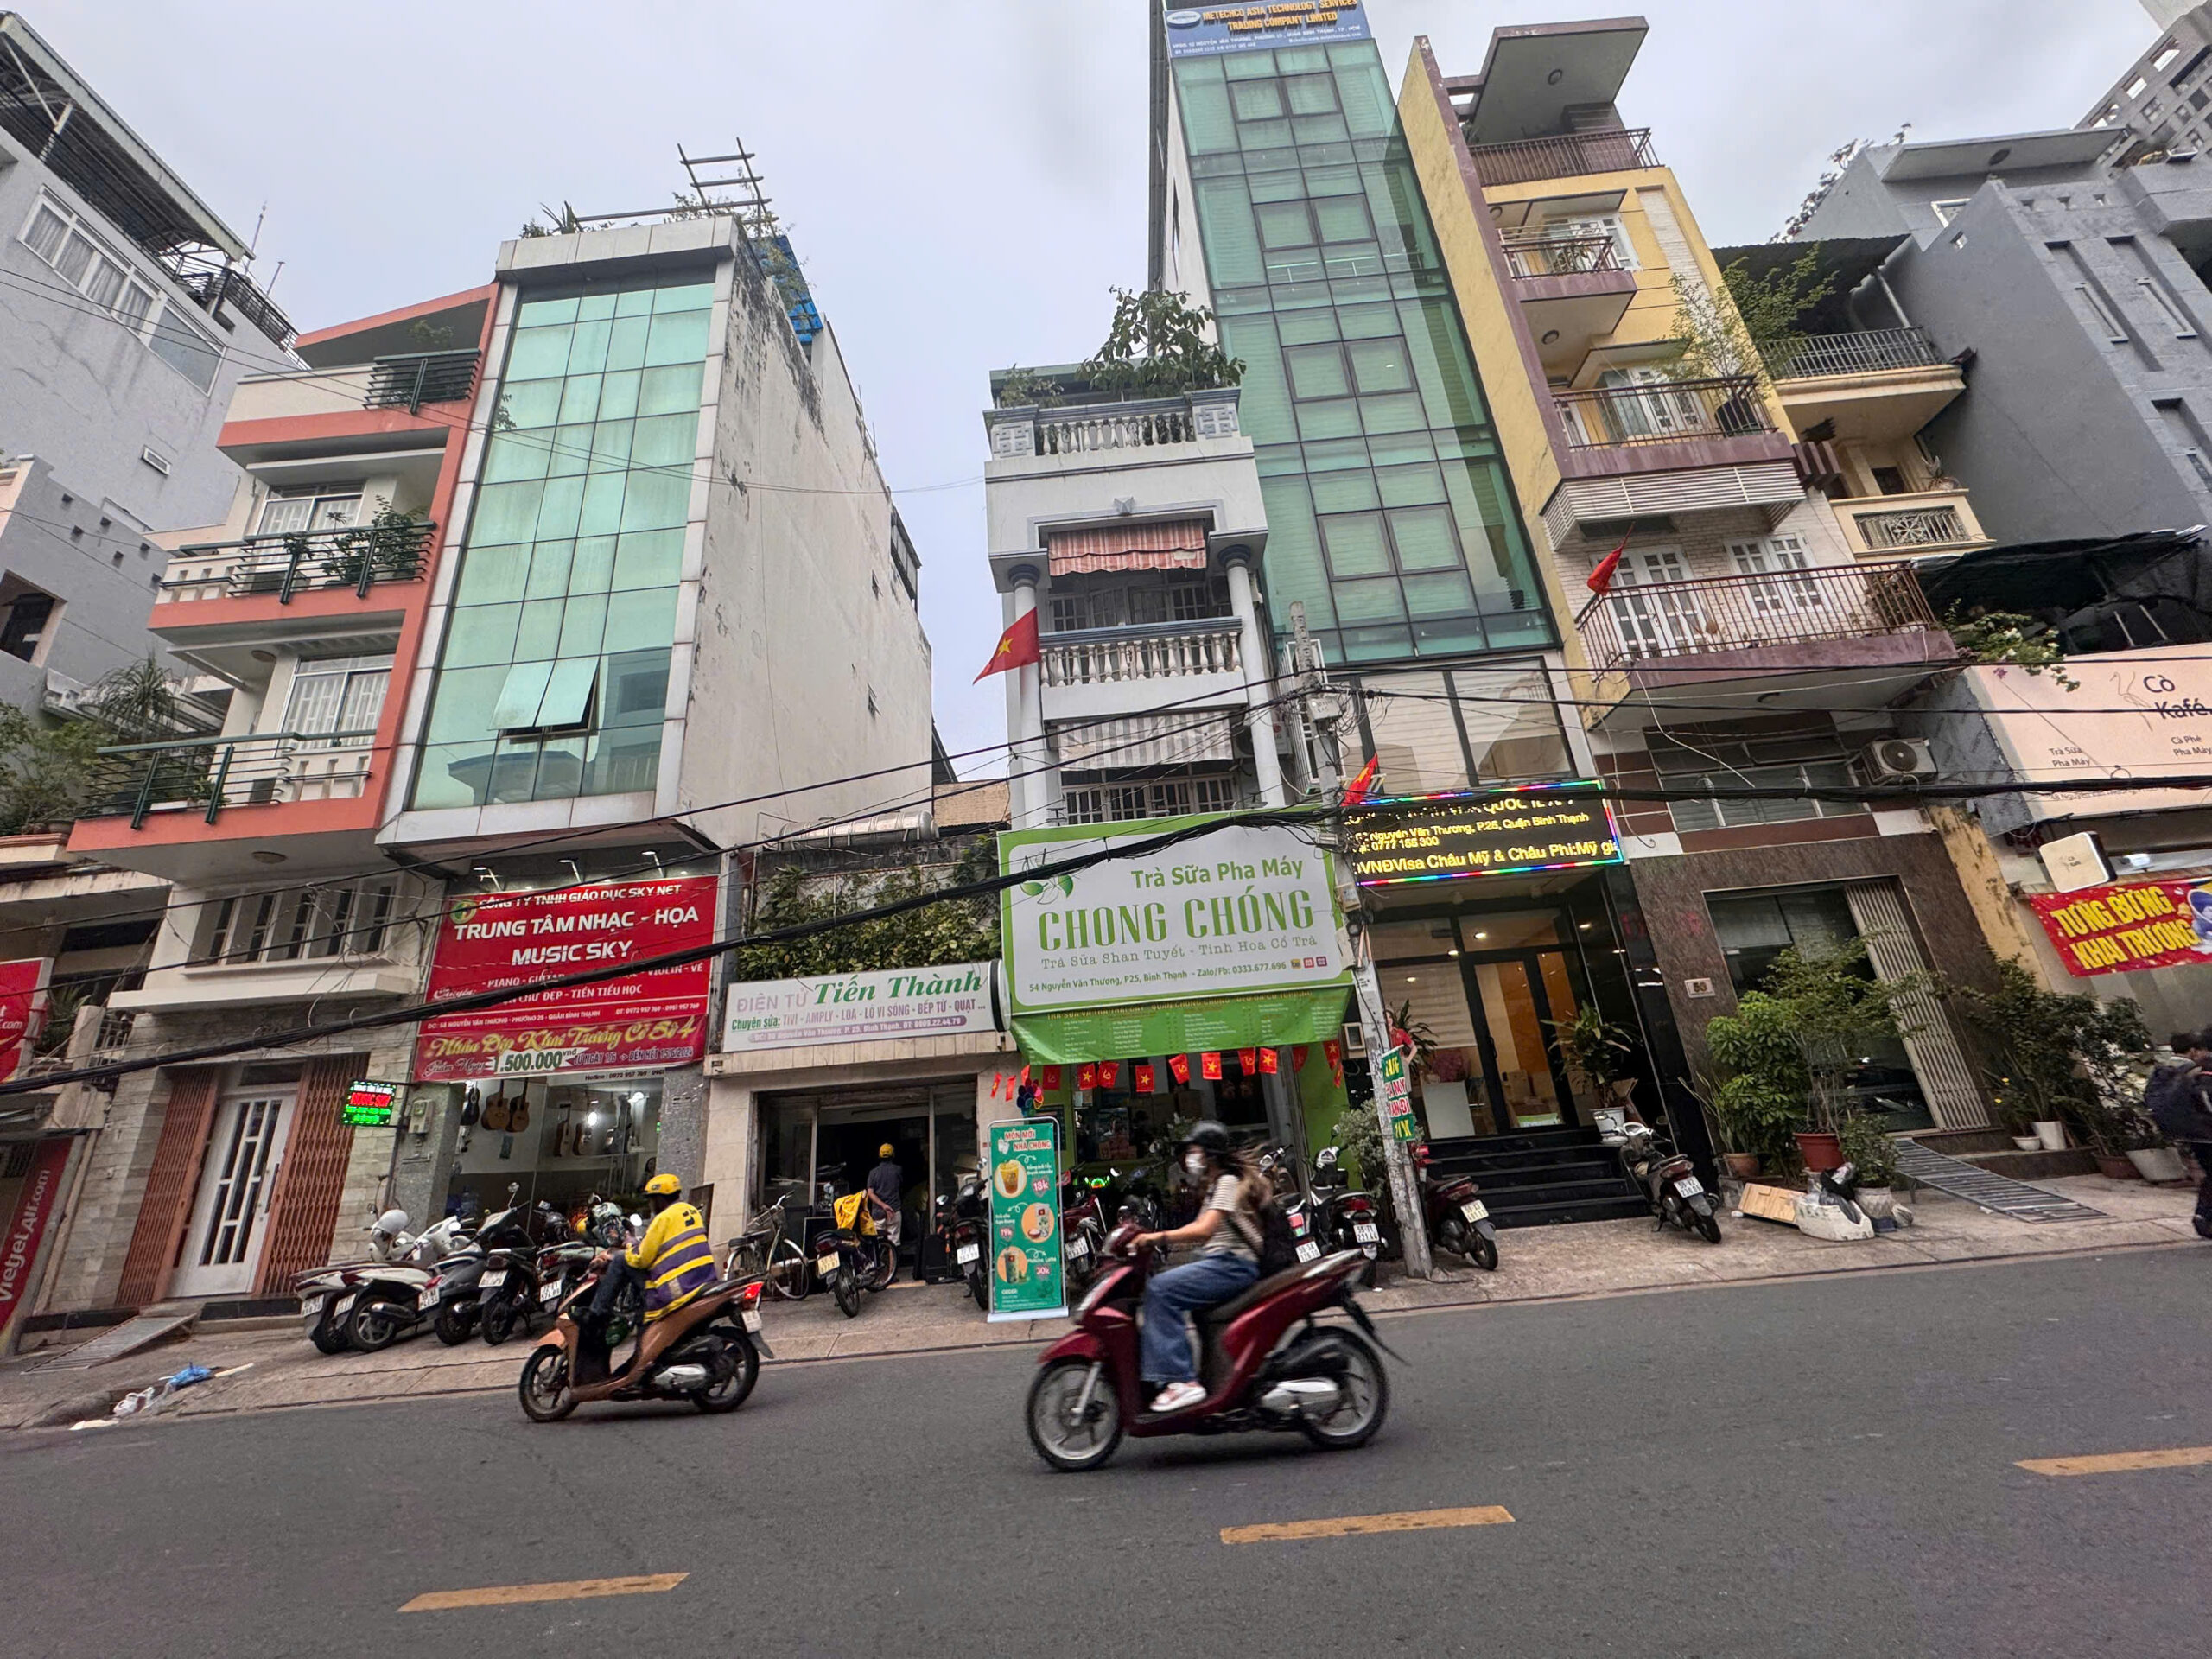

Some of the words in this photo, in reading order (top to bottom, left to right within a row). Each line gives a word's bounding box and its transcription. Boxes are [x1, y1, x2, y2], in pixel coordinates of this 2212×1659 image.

[1246, 6, 1266, 16] ASIA
[1267, 2, 1316, 14] TECHNOLOGY
[1228, 20, 1262, 31] TRADING
[1263, 15, 1302, 27] COMPANY
[1306, 11, 1338, 23] LIMITED
[2144, 674, 2176, 693] Cò
[2171, 736, 2183, 745] Cà
[2185, 734, 2202, 744] Phê
[2048, 747, 2064, 758] Trà
[2065, 744, 2083, 757] Sữa
[2075, 757, 2091, 766] Máy
[2173, 747, 2193, 758] Pha
[2196, 744, 2212, 756] Máy
[1408, 825, 1431, 837] Văn
[1503, 818, 1531, 830] Quận
[1532, 815, 1556, 827] Bình
[1555, 812, 1590, 826] Thạnh
[1370, 837, 1398, 853] 0777
[1420, 835, 1440, 848] 300
[1426, 850, 1467, 869] Châu
[1467, 849, 1491, 867] Mỹ
[1493, 848, 1506, 863] &
[1507, 844, 1548, 861] Châu
[1130, 866, 1166, 889] Trà
[1171, 863, 1211, 886] Sữa
[1217, 861, 1256, 882] Pha
[1262, 855, 1303, 880] Máy
[536, 893, 568, 905] TNHH
[569, 889, 599, 903] GIÁO
[600, 888, 628, 902] DỤC
[628, 887, 654, 897] SKY
[656, 884, 683, 896] NET
[1039, 901, 1168, 952] CHONG
[1184, 884, 1314, 938] CHÓNG
[2049, 899, 2119, 938] TƯNG
[2106, 885, 2177, 925] BỪNG
[454, 920, 527, 941] TRUNG
[531, 913, 575, 935] TÂM
[577, 910, 636, 932] NHẠC
[654, 906, 699, 929] HỌA
[511, 944, 582, 966] MUSIC
[585, 939, 633, 961] SKY
[1040, 957, 1066, 969] Trà
[1070, 952, 1098, 968] Sữa
[1102, 950, 1140, 964] Shan
[1143, 944, 1185, 961] Tuyết
[1237, 938, 1268, 953] Hoa
[1293, 934, 1318, 947] Trà
[2069, 935, 2129, 970] KHAI
[2116, 918, 2202, 960] TRƯƠNG
[487, 976, 520, 988] PIANO
[1029, 983, 1039, 993] 54
[1041, 977, 1071, 993] Nguyễn
[1072, 978, 1088, 989] Văn
[1089, 975, 1122, 988] Thương,
[1123, 973, 1142, 984] P25,
[1143, 970, 1161, 982] Bình
[1162, 969, 1188, 982] Thạnh
[1197, 963, 1231, 977] Zalo/Fb:
[1232, 960, 1287, 975] 0333.677.696
[543, 988, 563, 1002] ĐẸP
[622, 984, 643, 999] HỌC
[736, 993, 779, 1014] ĐIỆN
[783, 987, 809, 1009] TỬ
[814, 974, 876, 1005] Tiến
[887, 969, 982, 1000] Thành
[731, 1018, 761, 1032] Chuyên
[783, 1013, 798, 1027] TIVI
[805, 1009, 834, 1025] AMPLY
[841, 1008, 857, 1021] LOA
[877, 1005, 886, 1018] VI
[887, 1001, 910, 1017] SÓNG
[918, 1000, 934, 1014] BẾP
[954, 998, 976, 1014] QUẠT
[677, 1014, 697, 1038] 4
[493, 1050, 563, 1072] 1.500.000
[1004, 1128, 1020, 1141] MÓN
[1021, 1127, 1036, 1139] MỚI
[1028, 1140, 1052, 1150] CHONG
[1033, 1179, 1049, 1192] 18k
